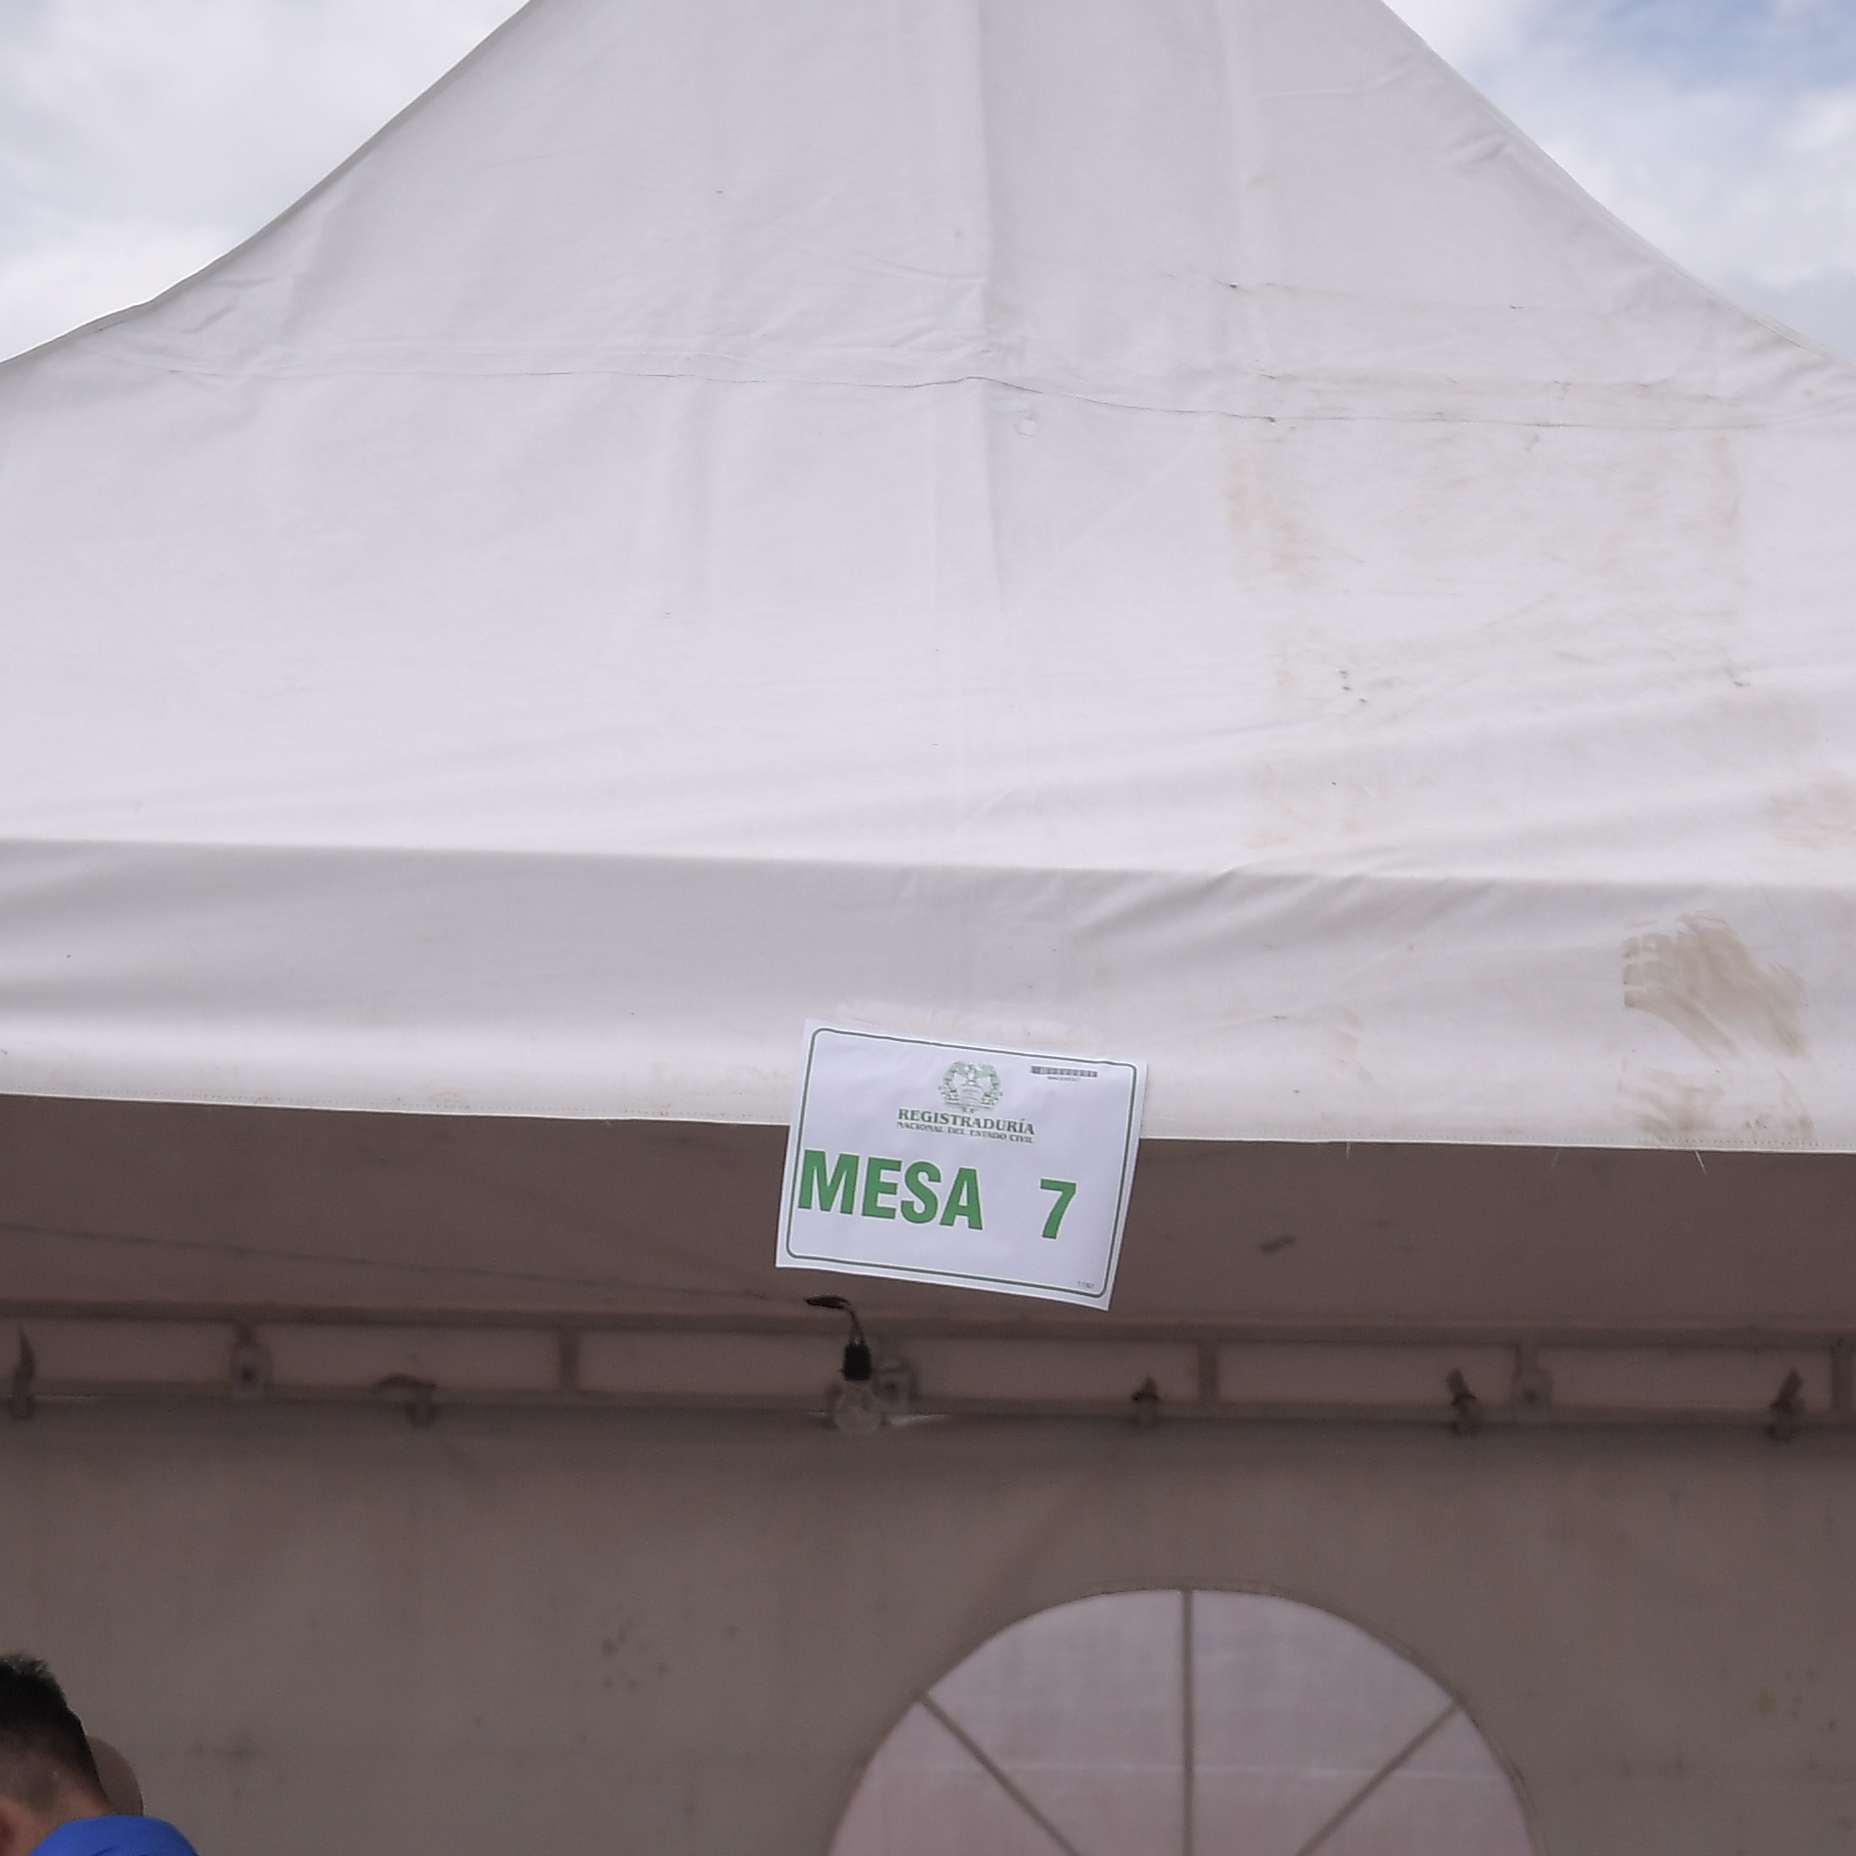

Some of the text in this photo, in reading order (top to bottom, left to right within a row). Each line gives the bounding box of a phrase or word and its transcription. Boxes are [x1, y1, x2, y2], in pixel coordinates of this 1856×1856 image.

[898, 1108, 1035, 1136] REGISTRADURÍA
[797, 1149, 1077, 1240] MESA 7
